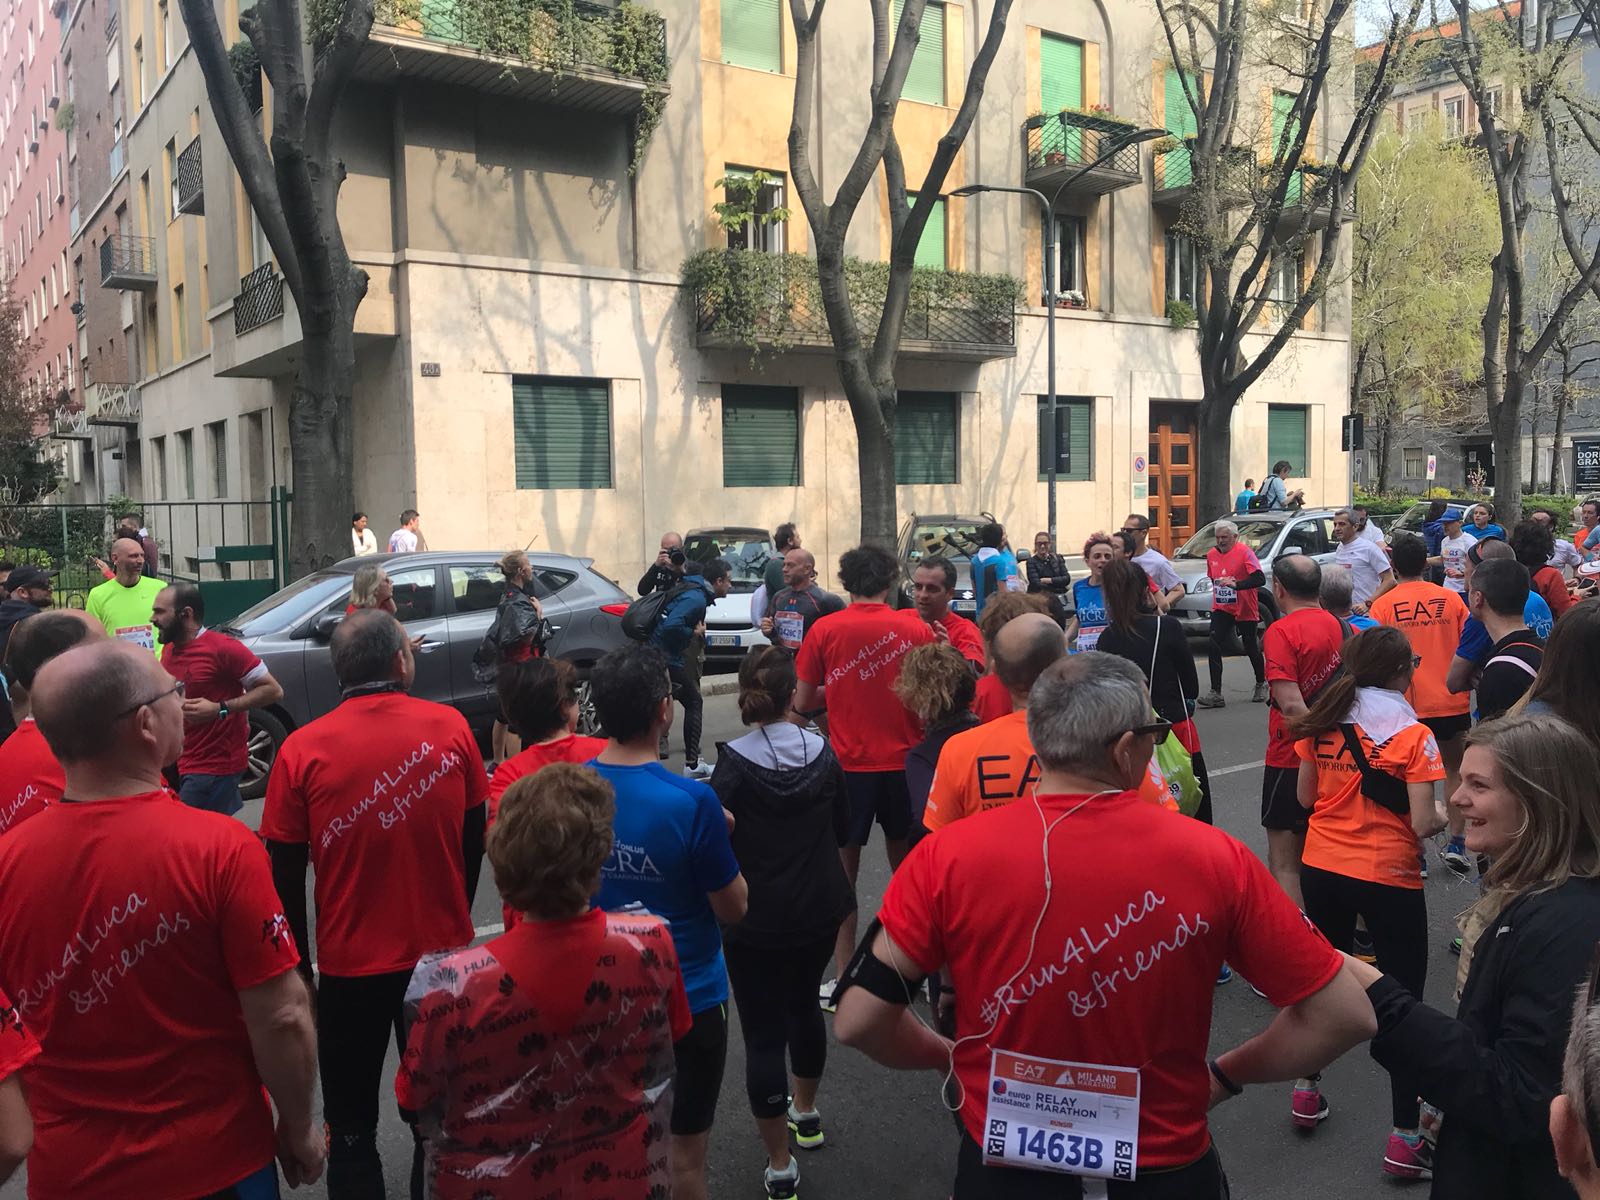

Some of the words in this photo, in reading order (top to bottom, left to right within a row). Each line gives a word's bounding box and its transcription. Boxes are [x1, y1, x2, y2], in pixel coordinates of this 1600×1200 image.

[1393, 598, 1448, 622] EA7
[826, 631, 898, 686] #Run4Luca
[859, 639, 913, 681] &friends
[321, 741, 434, 848] #Run4Luca
[378, 751, 461, 829] &friends
[613, 925, 662, 939] HUAWEI
[68, 911, 191, 1014] &friends
[979, 890, 1165, 1024] #Run4Luca
[1068, 912, 1210, 1017] &friends
[1013, 1061, 1047, 1079] EA7
[1077, 1071, 1117, 1085] MILANO
[991, 1096, 1031, 1110] assistance
[1007, 1090, 1031, 1101] europ
[1035, 1102, 1098, 1119] MARATHON
[1036, 1092, 1078, 1107] RELAY
[1017, 1126, 1104, 1170] 1463B
